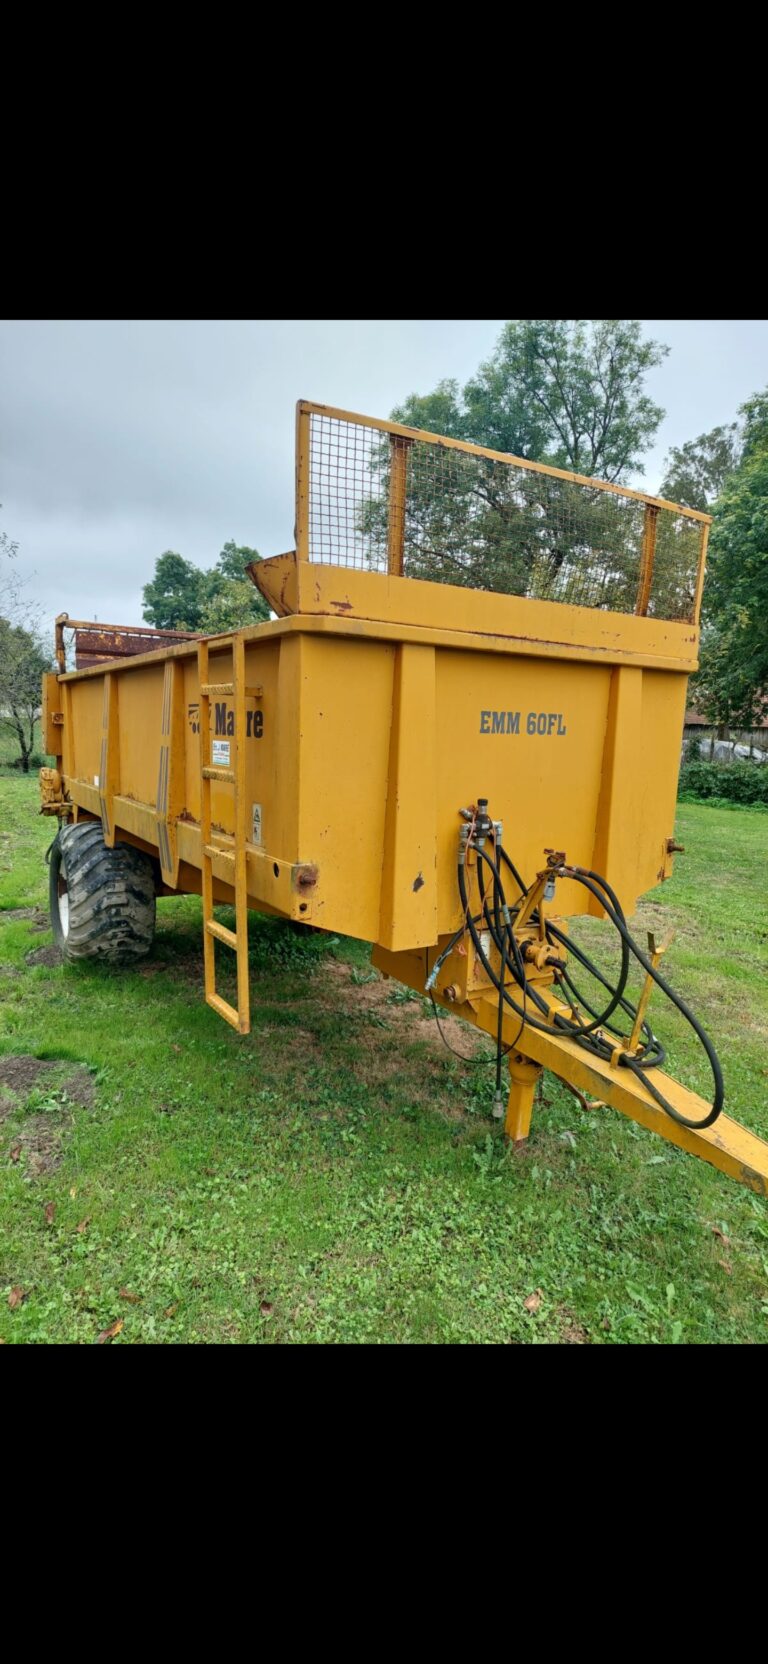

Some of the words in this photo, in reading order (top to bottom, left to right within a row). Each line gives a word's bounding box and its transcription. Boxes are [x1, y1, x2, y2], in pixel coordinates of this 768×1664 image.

[214, 702, 264, 738] Mare
[479, 710, 521, 735] EMM
[526, 712, 567, 736] 60FL
